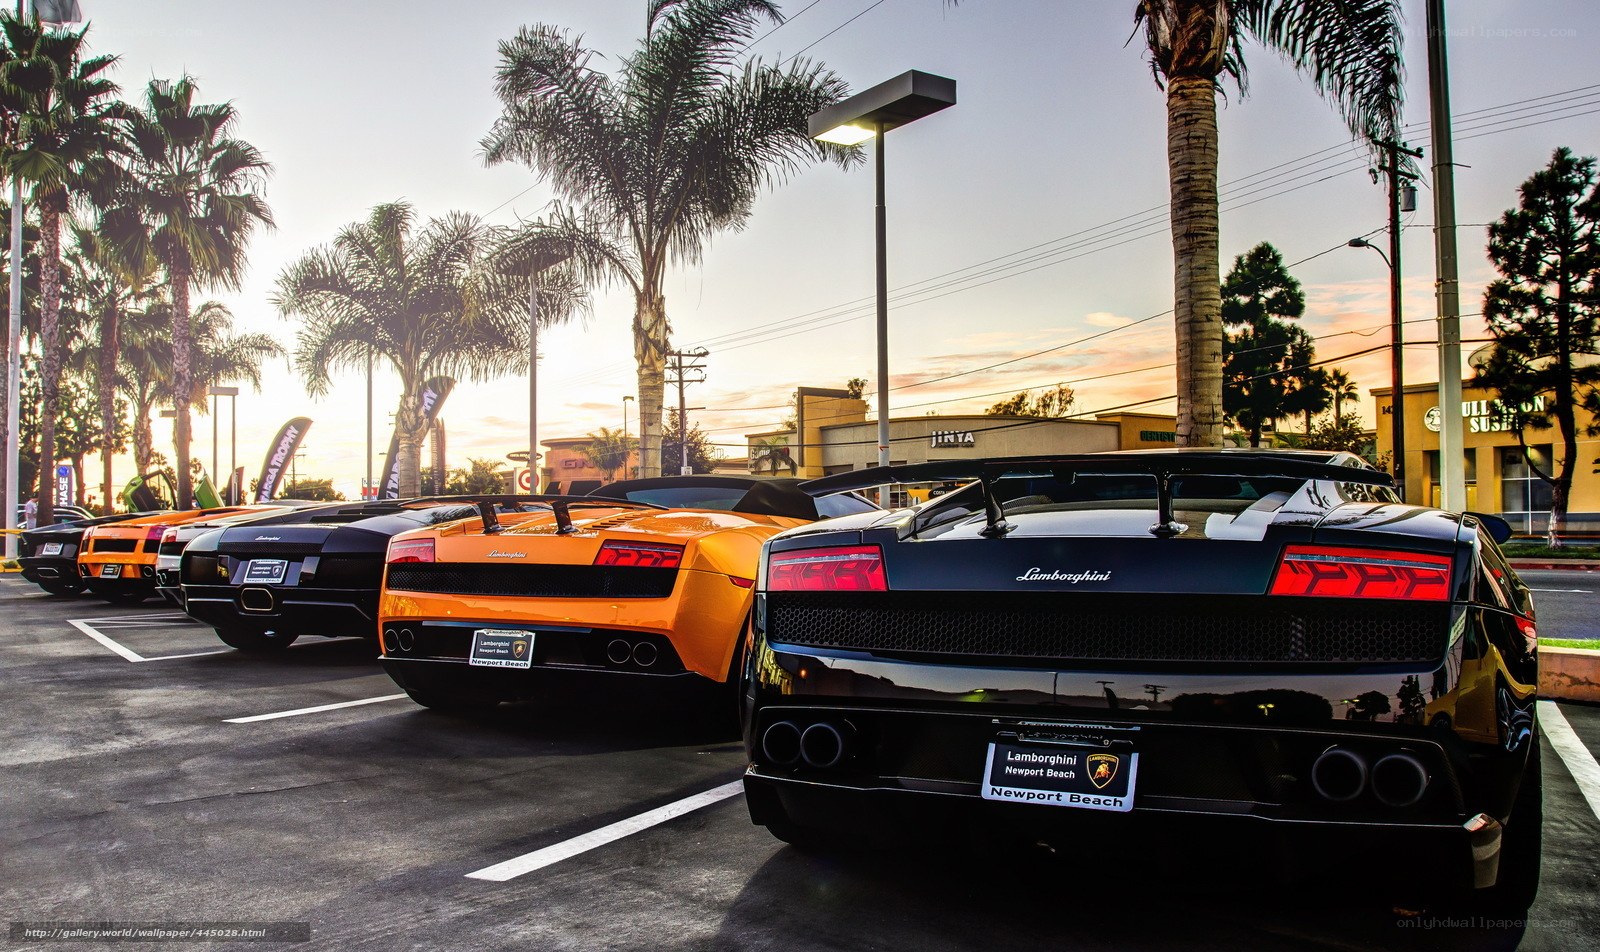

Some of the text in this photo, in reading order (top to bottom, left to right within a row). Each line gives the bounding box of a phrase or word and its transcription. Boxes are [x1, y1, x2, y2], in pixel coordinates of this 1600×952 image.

[1381, 405, 1393, 415] 14
[1461, 399, 1490, 417] ULL
[270, 425, 299, 467] TROPHY
[931, 430, 975, 448] JINYA
[59, 477, 68, 506] HASE
[1016, 567, 1112, 585] Lamborghini
[480, 640, 510, 648] Lamborghini
[504, 660, 529, 668] Beach
[1007, 750, 1077, 766] Lamborghini
[1005, 766, 1076, 779] Newport Beach
[990, 787, 1124, 808] Newport Beach
